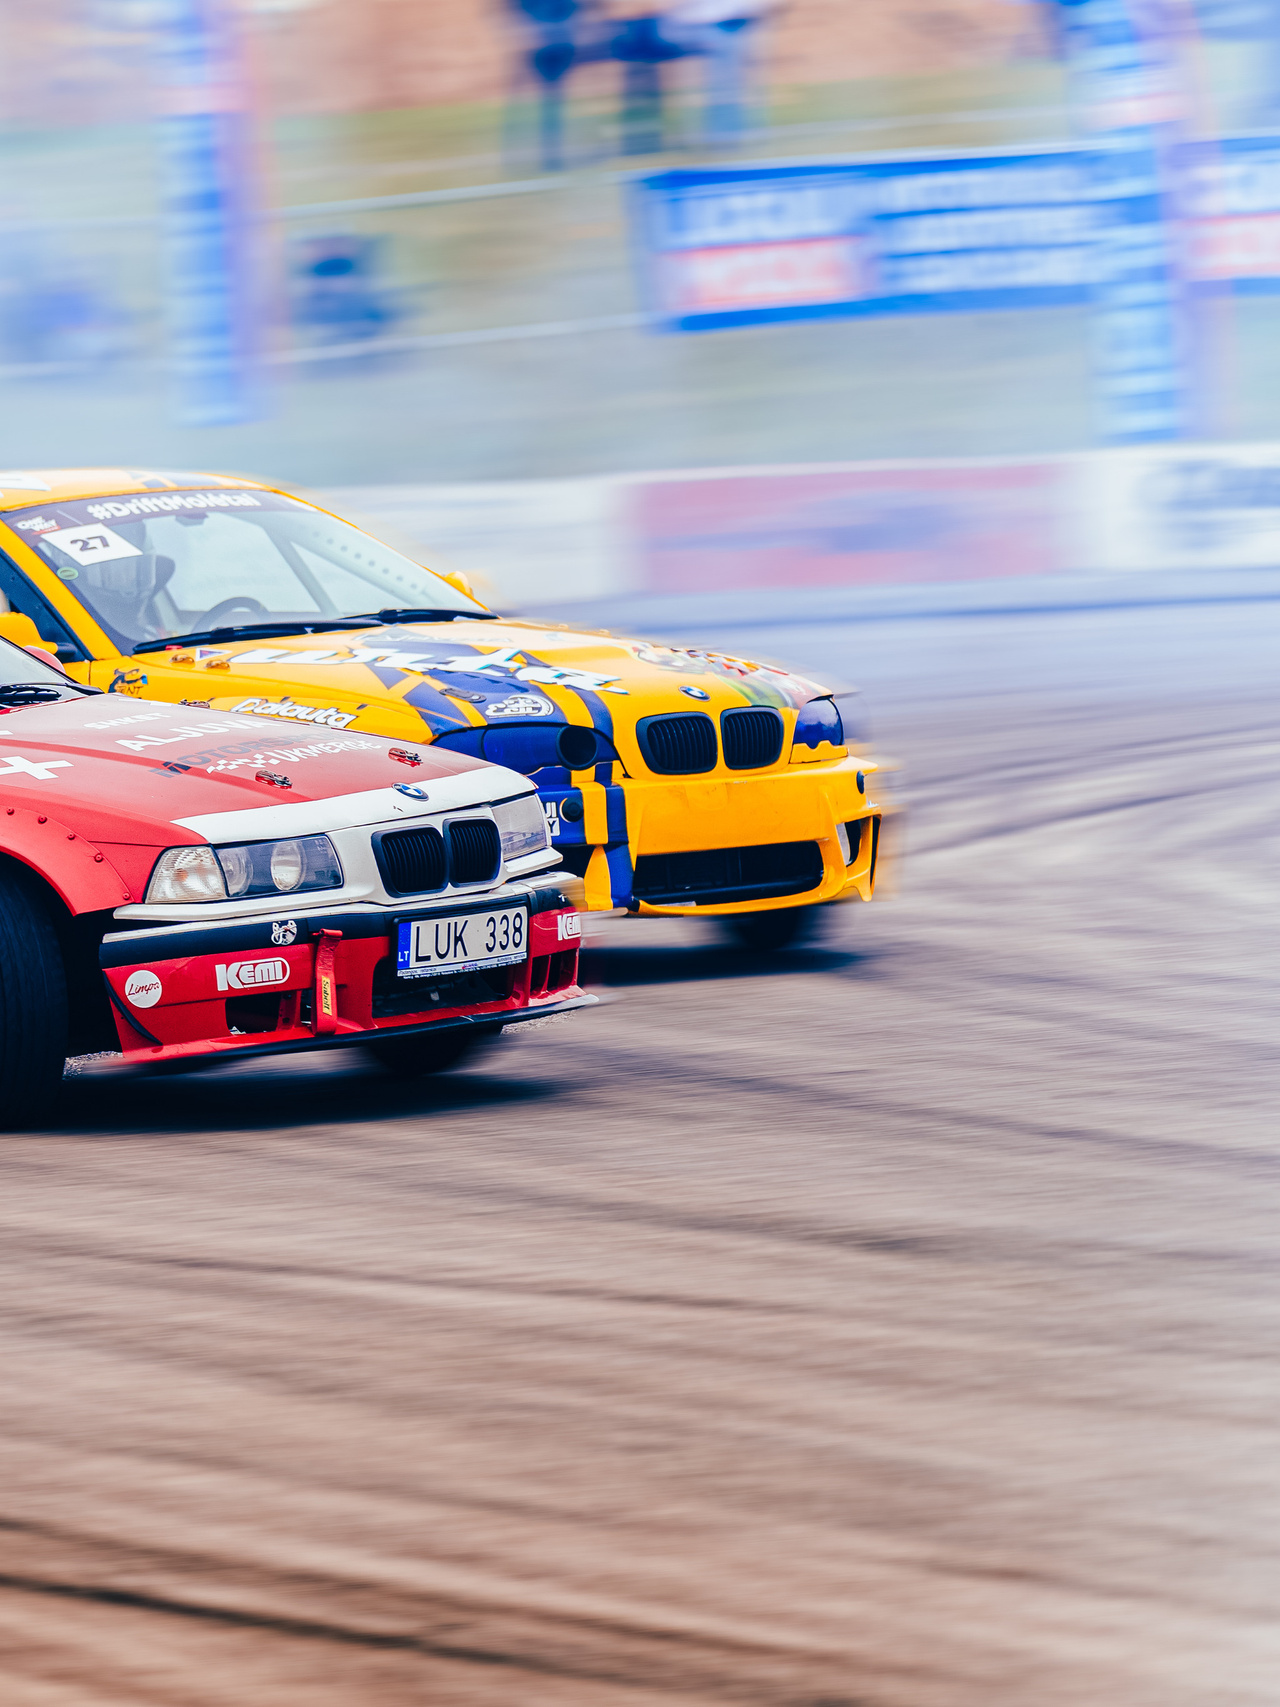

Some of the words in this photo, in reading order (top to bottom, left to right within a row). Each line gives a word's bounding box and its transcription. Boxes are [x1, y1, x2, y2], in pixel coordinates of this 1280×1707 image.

[70, 535, 110, 552] 27
[114, 719, 284, 752] ALJUVA
[415, 919, 469, 962] LUK
[485, 912, 523, 952] 338
[398, 950, 410, 962] LT
[215, 957, 290, 991] KEMI
